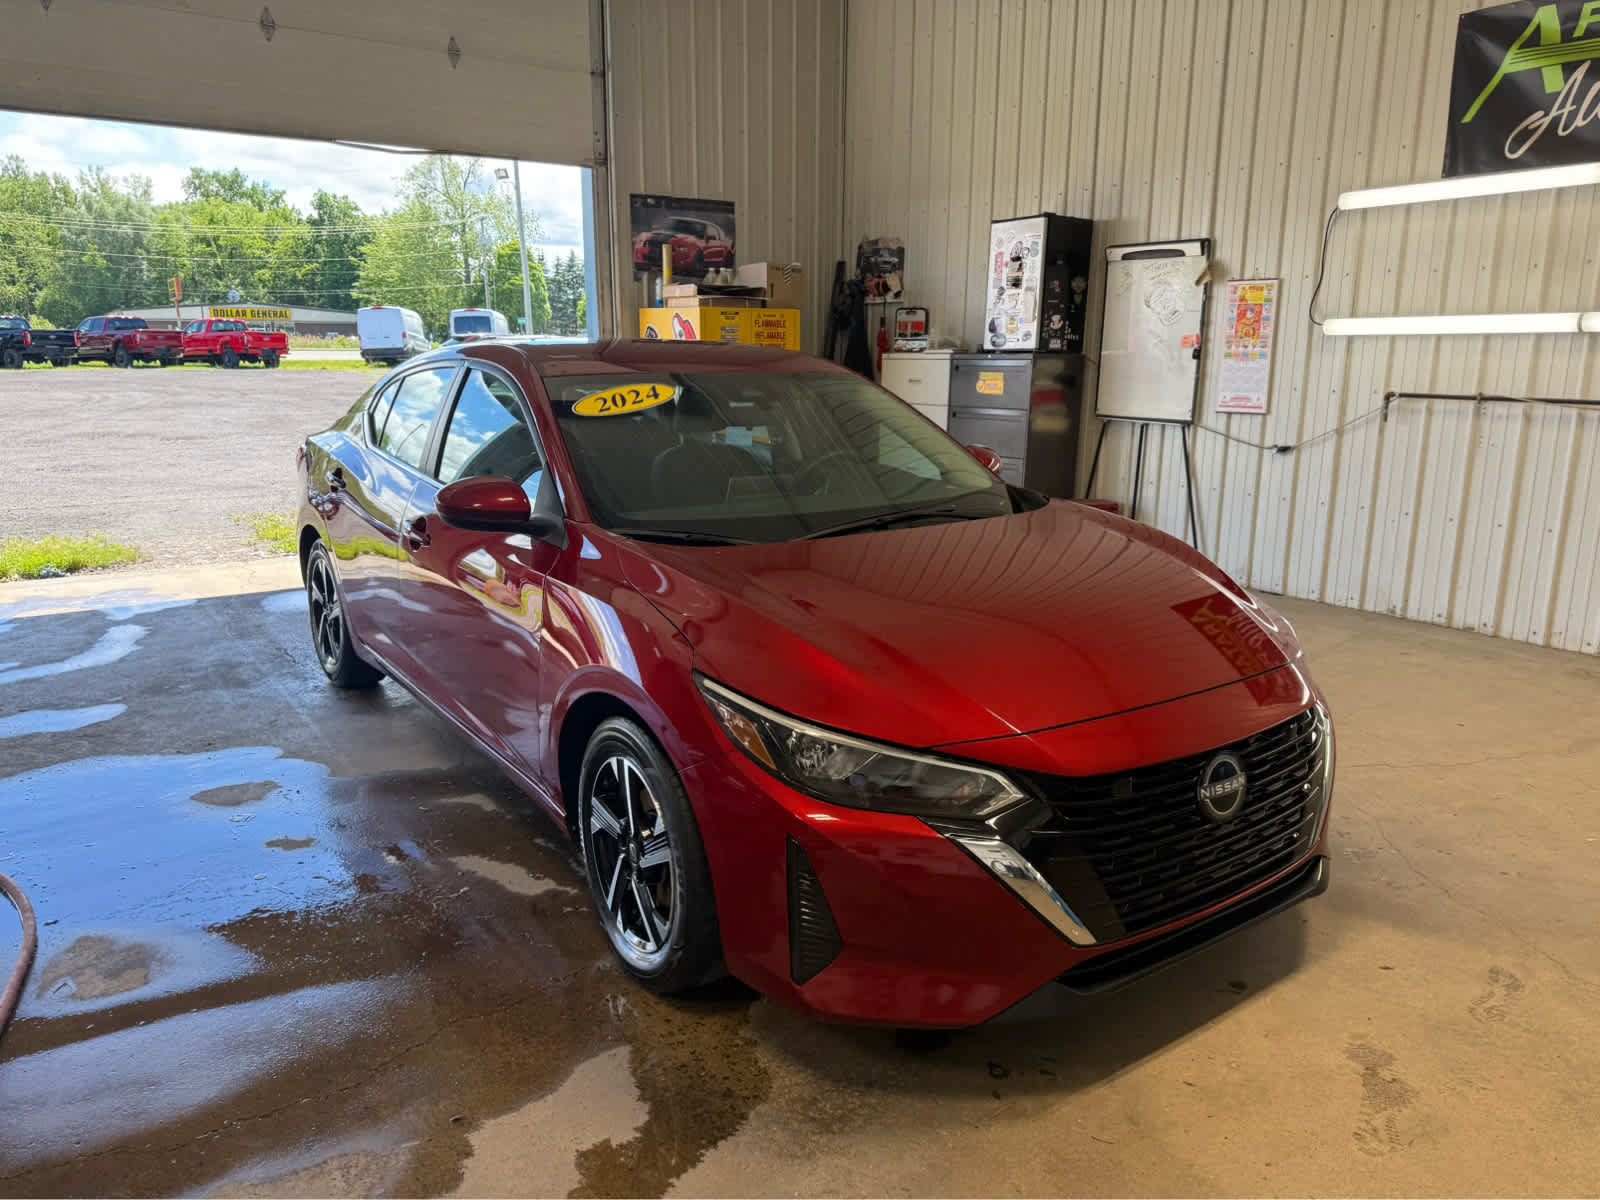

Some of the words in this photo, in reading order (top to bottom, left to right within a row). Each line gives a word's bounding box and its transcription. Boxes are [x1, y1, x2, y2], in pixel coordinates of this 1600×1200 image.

[213, 308, 248, 318] DOLLAR
[251, 309, 289, 319] GENERAL
[594, 385, 660, 413] 2024
[1200, 775, 1246, 801] NISSAN
